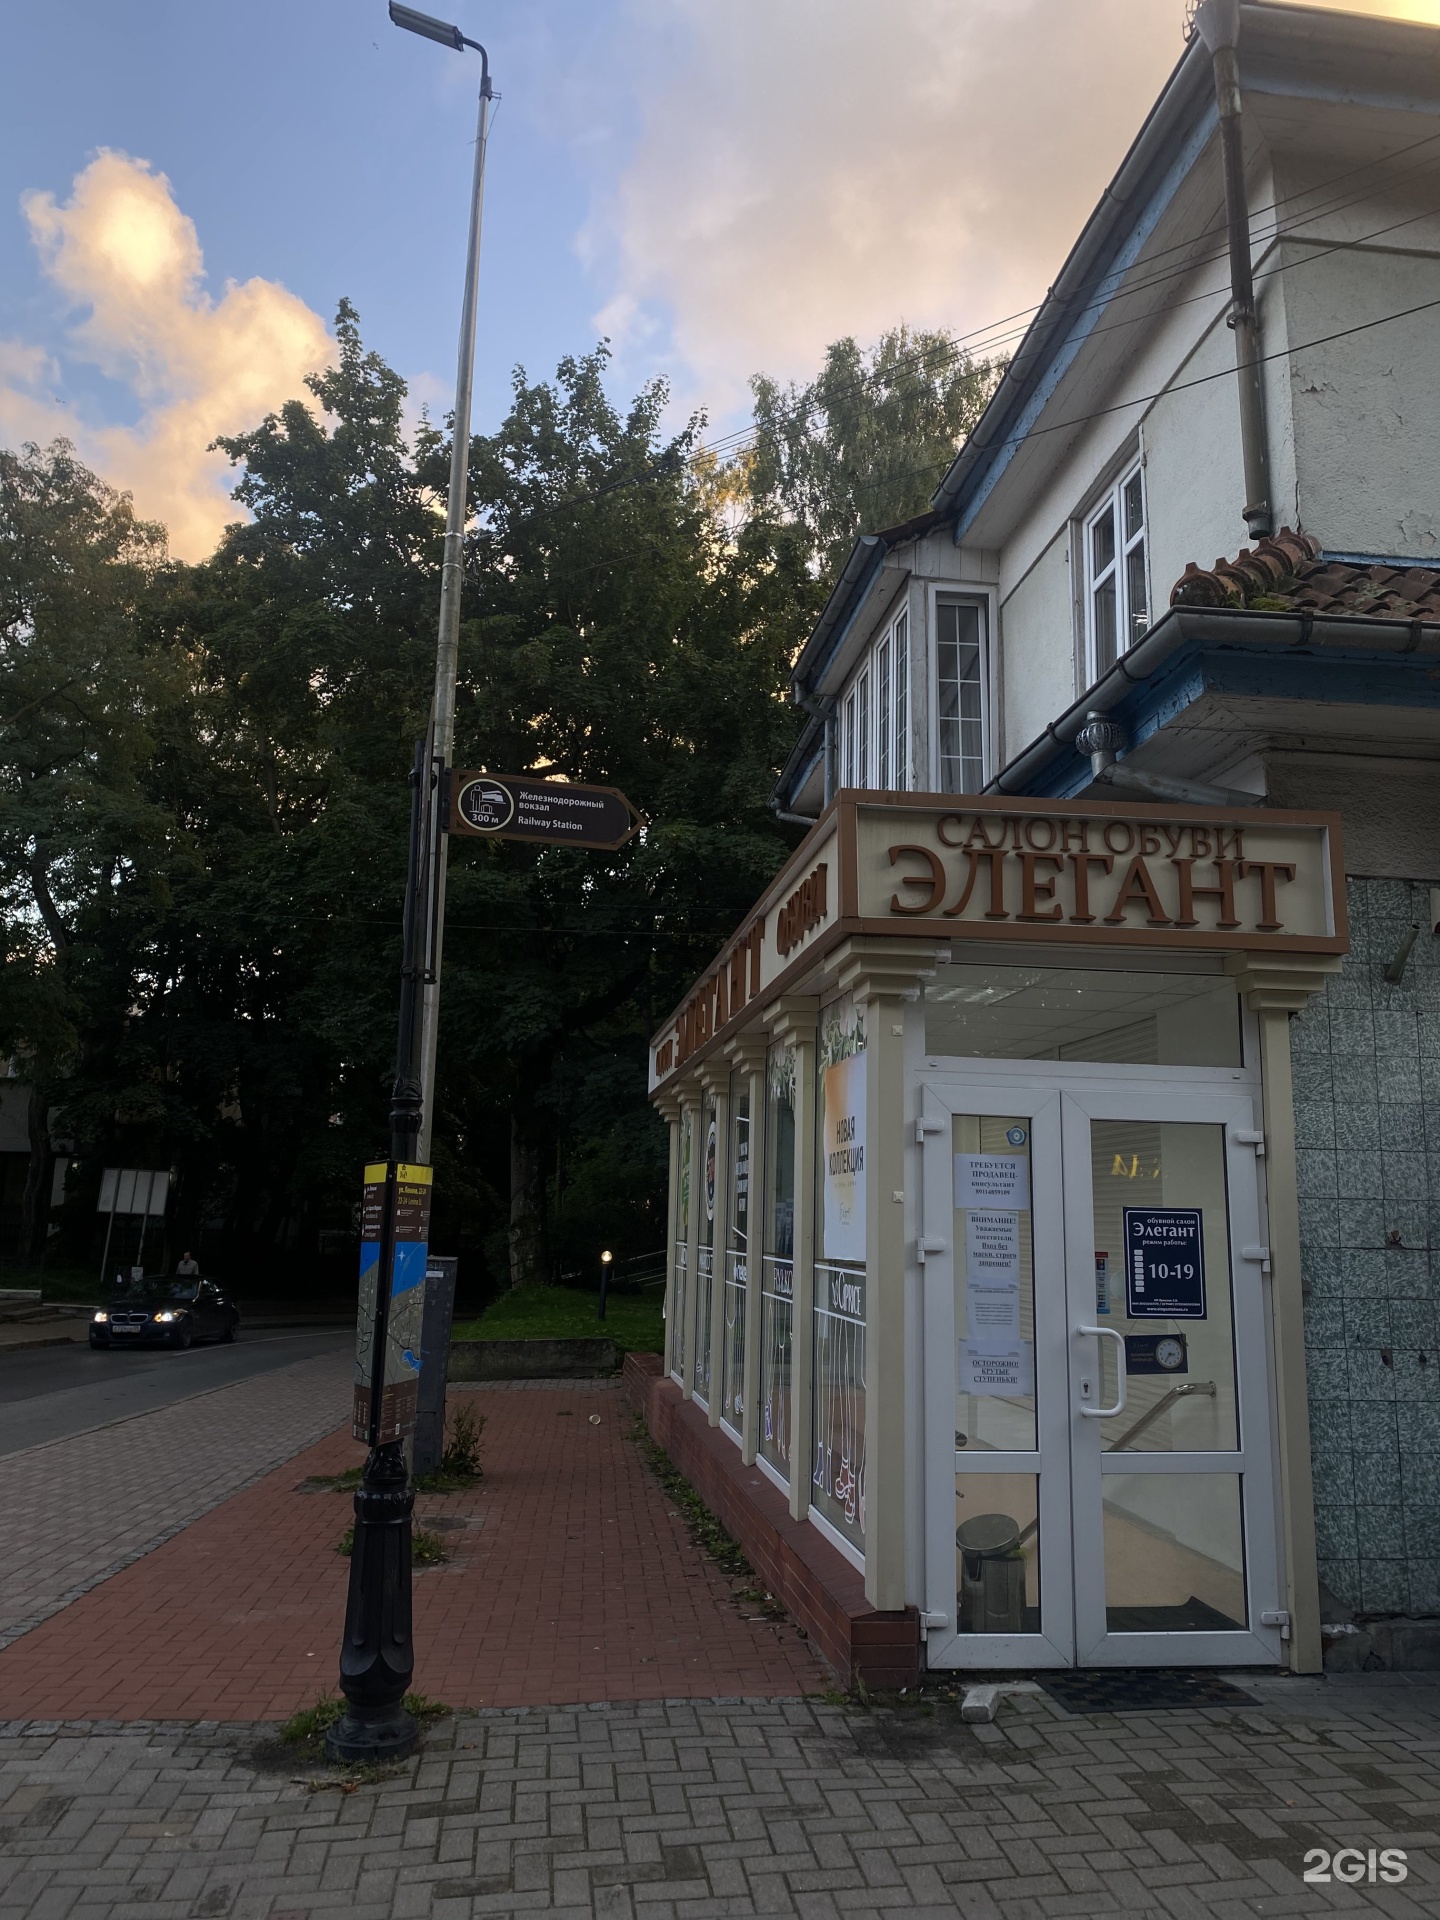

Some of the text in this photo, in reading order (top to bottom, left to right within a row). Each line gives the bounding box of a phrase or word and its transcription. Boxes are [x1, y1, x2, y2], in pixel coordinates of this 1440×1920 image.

[519, 791, 605, 809] Железнодорожный
[518, 802, 550, 812] вокзал
[472, 814, 499, 824] 300 м
[518, 816, 583, 831] Railway Station
[937, 814, 1246, 860] САЛОН ОБУВИ
[888, 844, 1297, 930] ЭЛЕГАНТ
[836, 1115, 856, 1145] НОВАЯ
[828, 1145, 864, 1179] КОЛЛЕКЦИЯ
[970, 1161, 1016, 1170] ТРЕБУЕТСЯ
[972, 1170, 1018, 1180] ПРОДАВЕЦ-
[971, 1180, 1015, 1188] консультант
[971, 1216, 1017, 1224] ВНИМАНИЕ!
[1146, 1217, 1175, 1225] обувной
[975, 1225, 1012, 1233] Уважаемые
[1133, 1222, 1196, 1238] Элегант
[982, 1242, 1008, 1250] Вход без
[1148, 1263, 1194, 1280] 10-19
[972, 1360, 1019, 1368] ОСТОРОЖНО!
[974, 1375, 1018, 1384] СТУПЕНЬКИ!
